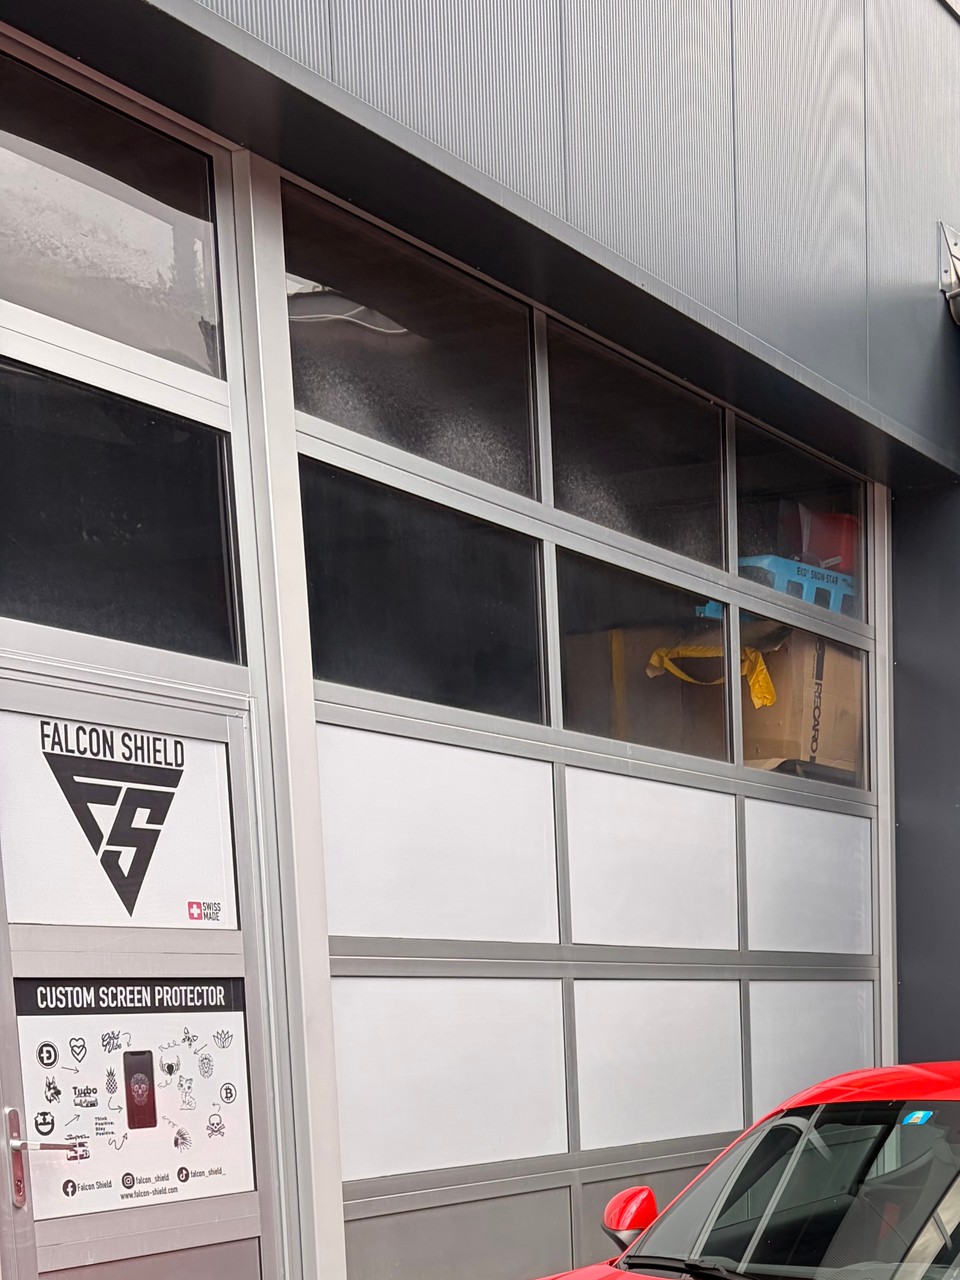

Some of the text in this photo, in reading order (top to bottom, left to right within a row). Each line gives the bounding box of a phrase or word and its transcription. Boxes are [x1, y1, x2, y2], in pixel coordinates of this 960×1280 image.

[810, 681, 823, 754] RECARO
[40, 720, 185, 768] FALCON SHIELD
[202, 901, 221, 911] SWISS
[203, 911, 220, 921] MADE
[36, 985, 225, 1009] CUSTOM SCREEN PROTECTOR
[77, 1180, 112, 1192] Falcon Shield
[136, 1173, 170, 1186] falcon_shield
[120, 1186, 179, 1200] www.falcon-shield.com
